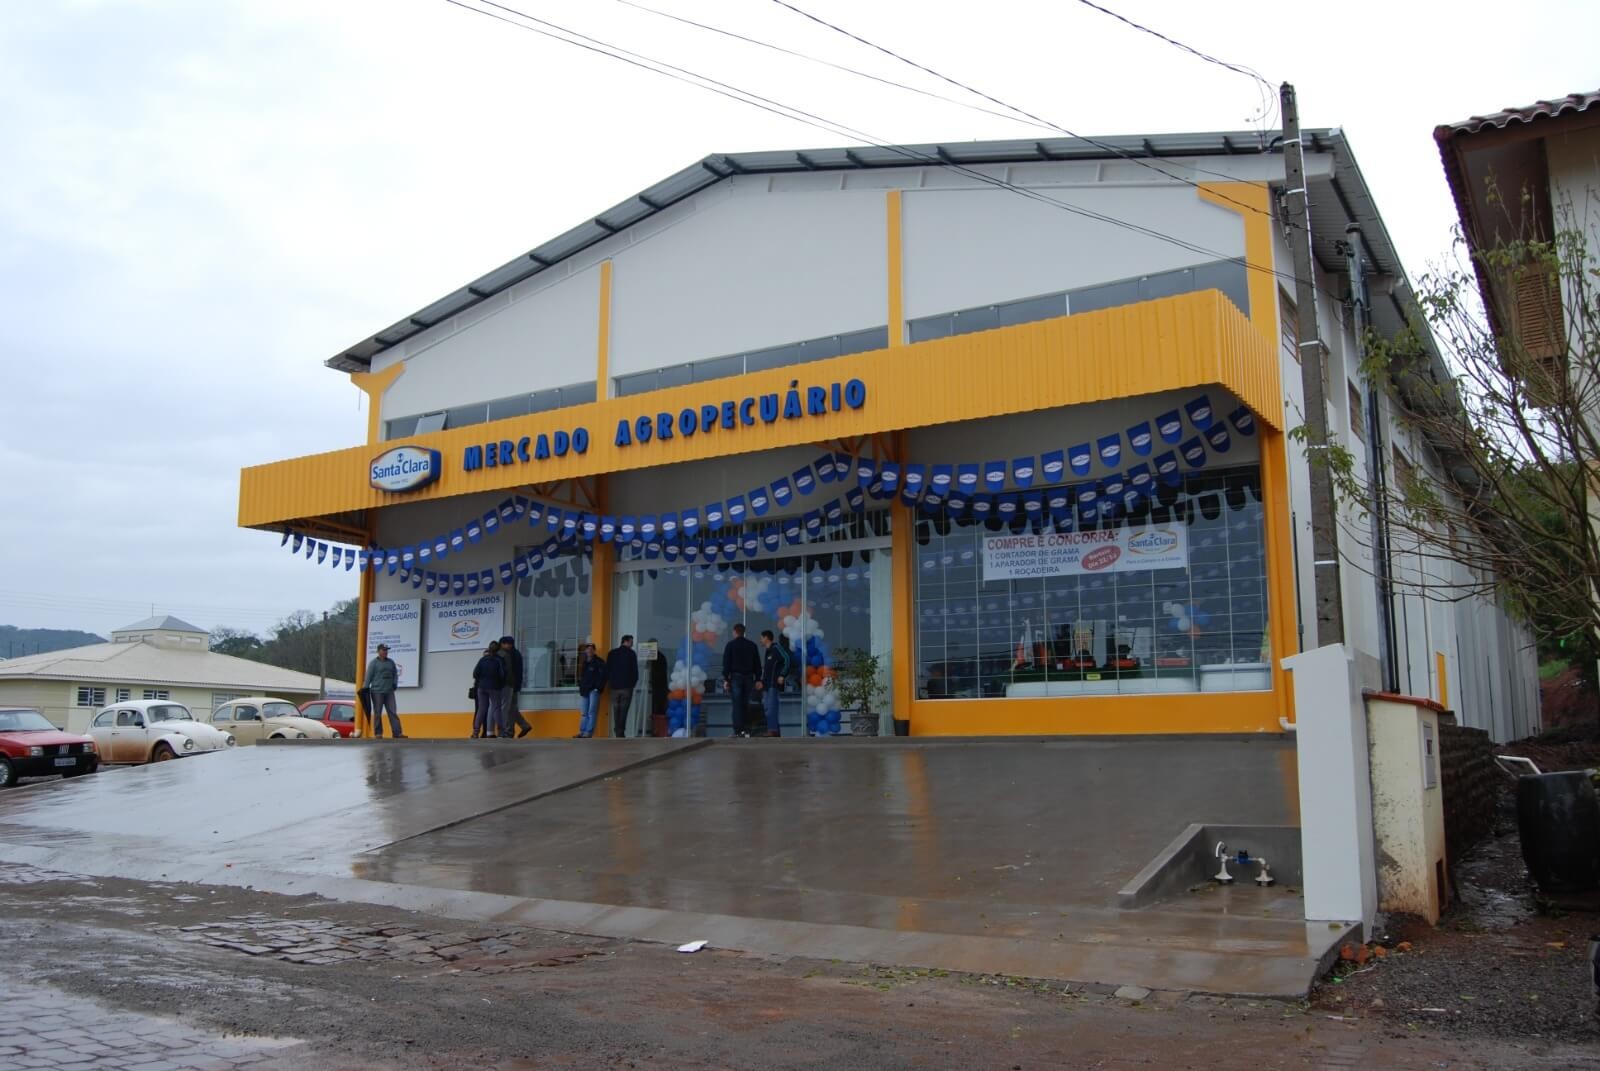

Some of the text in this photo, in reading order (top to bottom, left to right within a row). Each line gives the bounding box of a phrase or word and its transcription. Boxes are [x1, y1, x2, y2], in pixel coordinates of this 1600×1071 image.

[463, 379, 867, 471] MERCADO AGROPECUÁRIO
[373, 459, 429, 480] Santa Clara
[988, 531, 1119, 550] COMPRE E CONCORRA:
[1128, 536, 1176, 547] Santa Clara
[995, 550, 1036, 560] CORTADOR
[1039, 549, 1048, 557] DE
[1051, 548, 1080, 556] GRAMA
[995, 559, 1036, 568] APARADOR
[1051, 556, 1080, 564] GRAMA
[1014, 566, 1060, 577] ROÇADEIRA
[380, 603, 409, 612] MERCADO
[432, 600, 453, 609] SEJAM
[370, 611, 418, 622] AGROPECUÁRIO
[439, 610, 457, 618] BOAS
